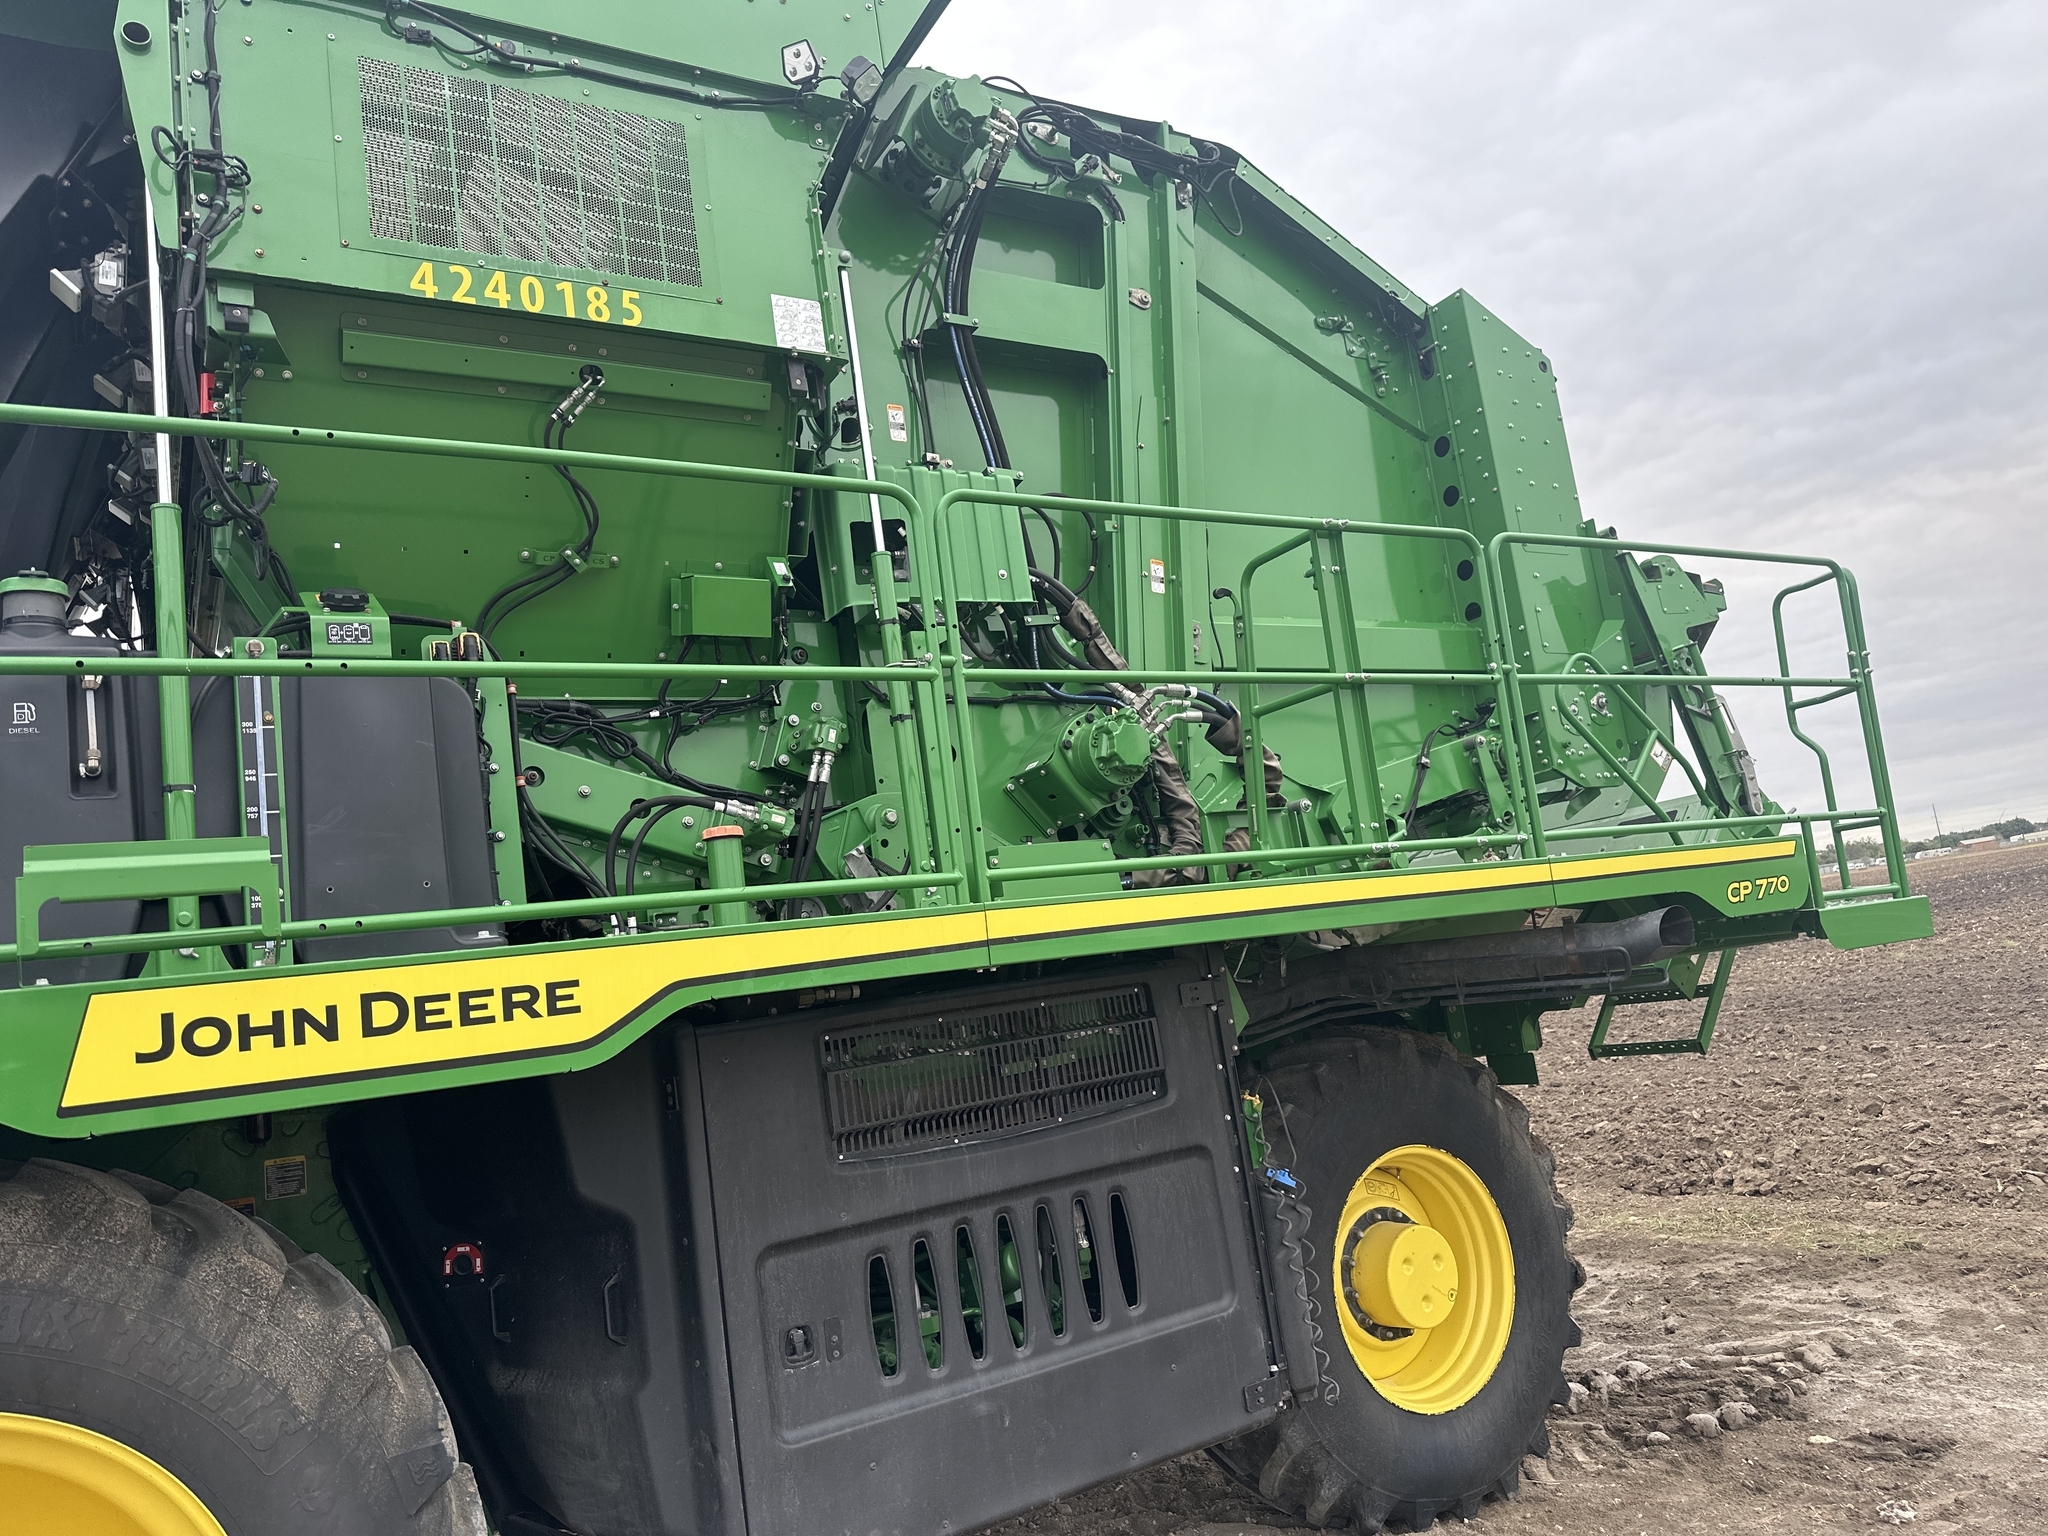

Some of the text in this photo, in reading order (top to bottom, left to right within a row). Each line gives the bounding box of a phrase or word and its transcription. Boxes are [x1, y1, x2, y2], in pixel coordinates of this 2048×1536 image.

[410, 261, 643, 327] 4240185
[592, 557, 605, 565] CS
[1726, 874, 1790, 904] CP 770
[136, 979, 582, 1064] JOHN DEERE
[103, 1316, 304, 1453] TERIS
